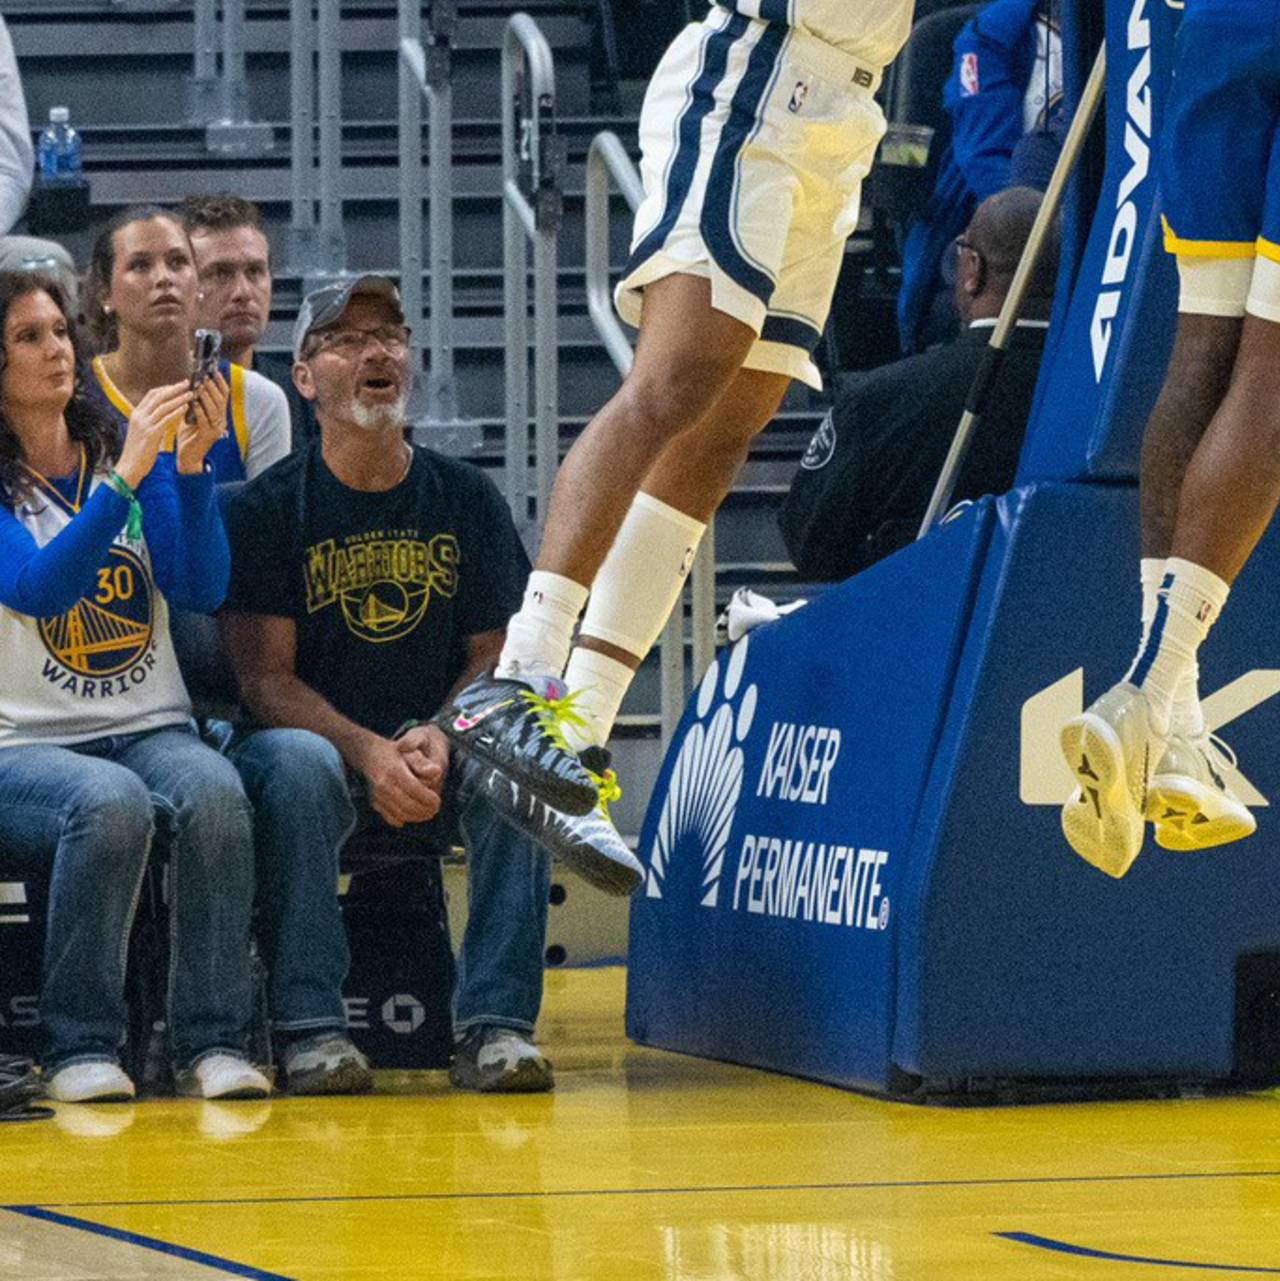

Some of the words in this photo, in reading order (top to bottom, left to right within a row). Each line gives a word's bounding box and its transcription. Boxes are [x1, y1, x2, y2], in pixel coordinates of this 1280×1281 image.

[94, 565, 134, 605] 30
[302, 533, 462, 615] WARRIORS
[756, 721, 842, 806] KAISER
